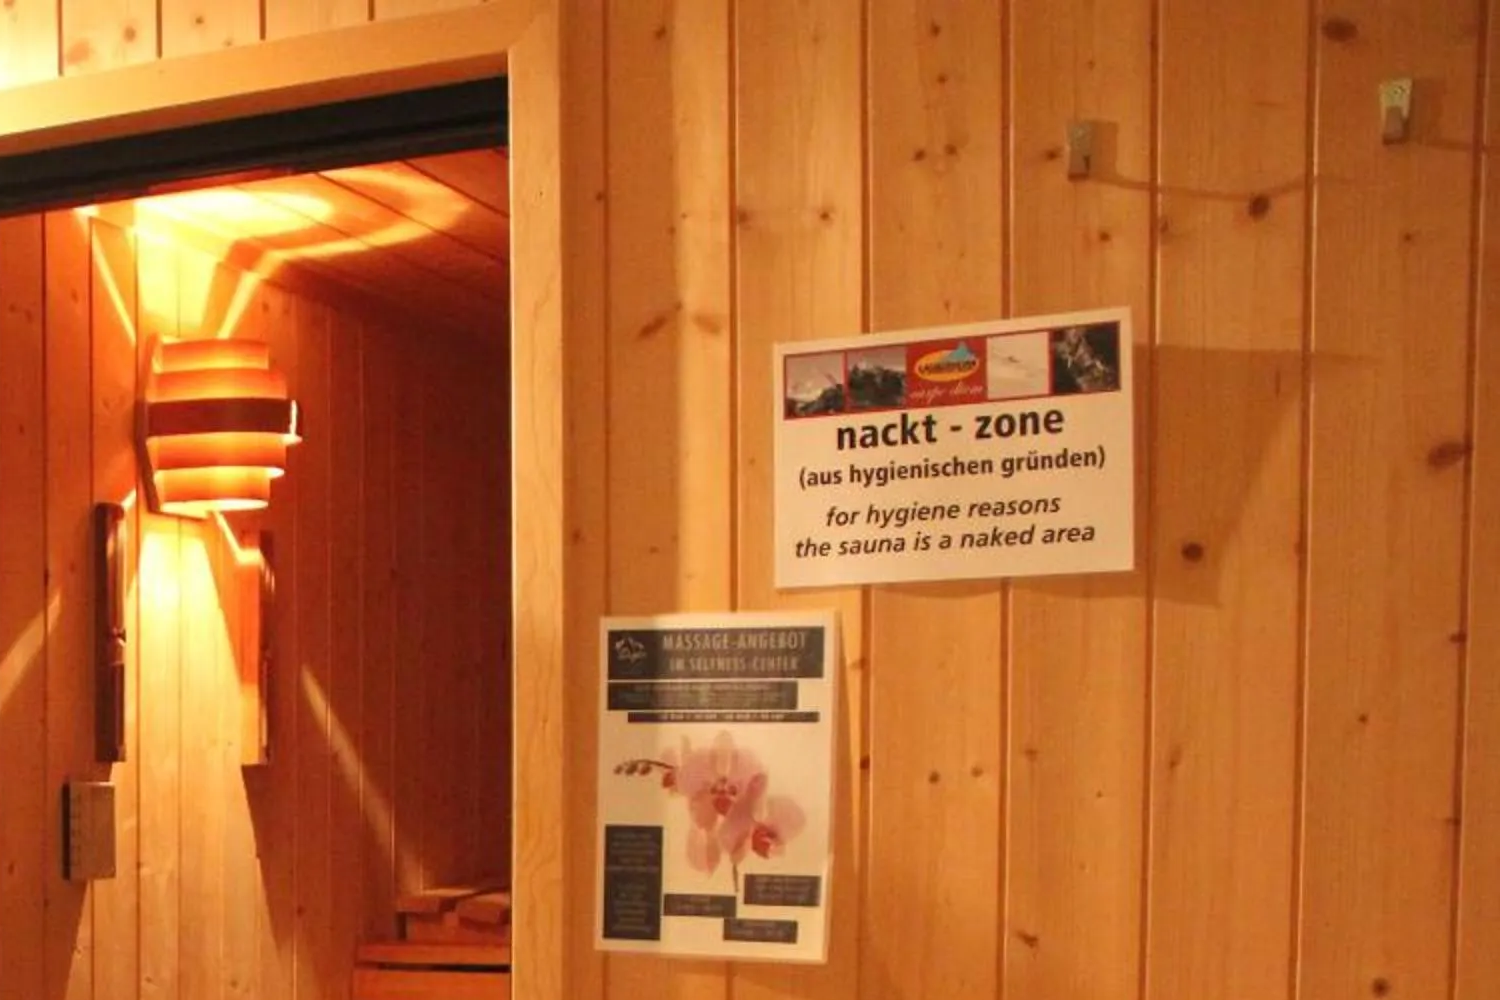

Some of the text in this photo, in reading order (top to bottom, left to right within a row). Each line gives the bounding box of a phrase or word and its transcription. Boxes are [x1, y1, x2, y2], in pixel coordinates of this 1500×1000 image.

[836, 412, 938, 451] nackt
[974, 408, 1066, 440] zone
[799, 445, 1106, 490] (aus hygienischen gründen)
[826, 496, 1062, 529] for hygiene reasons
[795, 524, 1096, 558] the sauna is a naked area
[663, 631, 806, 651] MASSAGE-ANGEBOT
